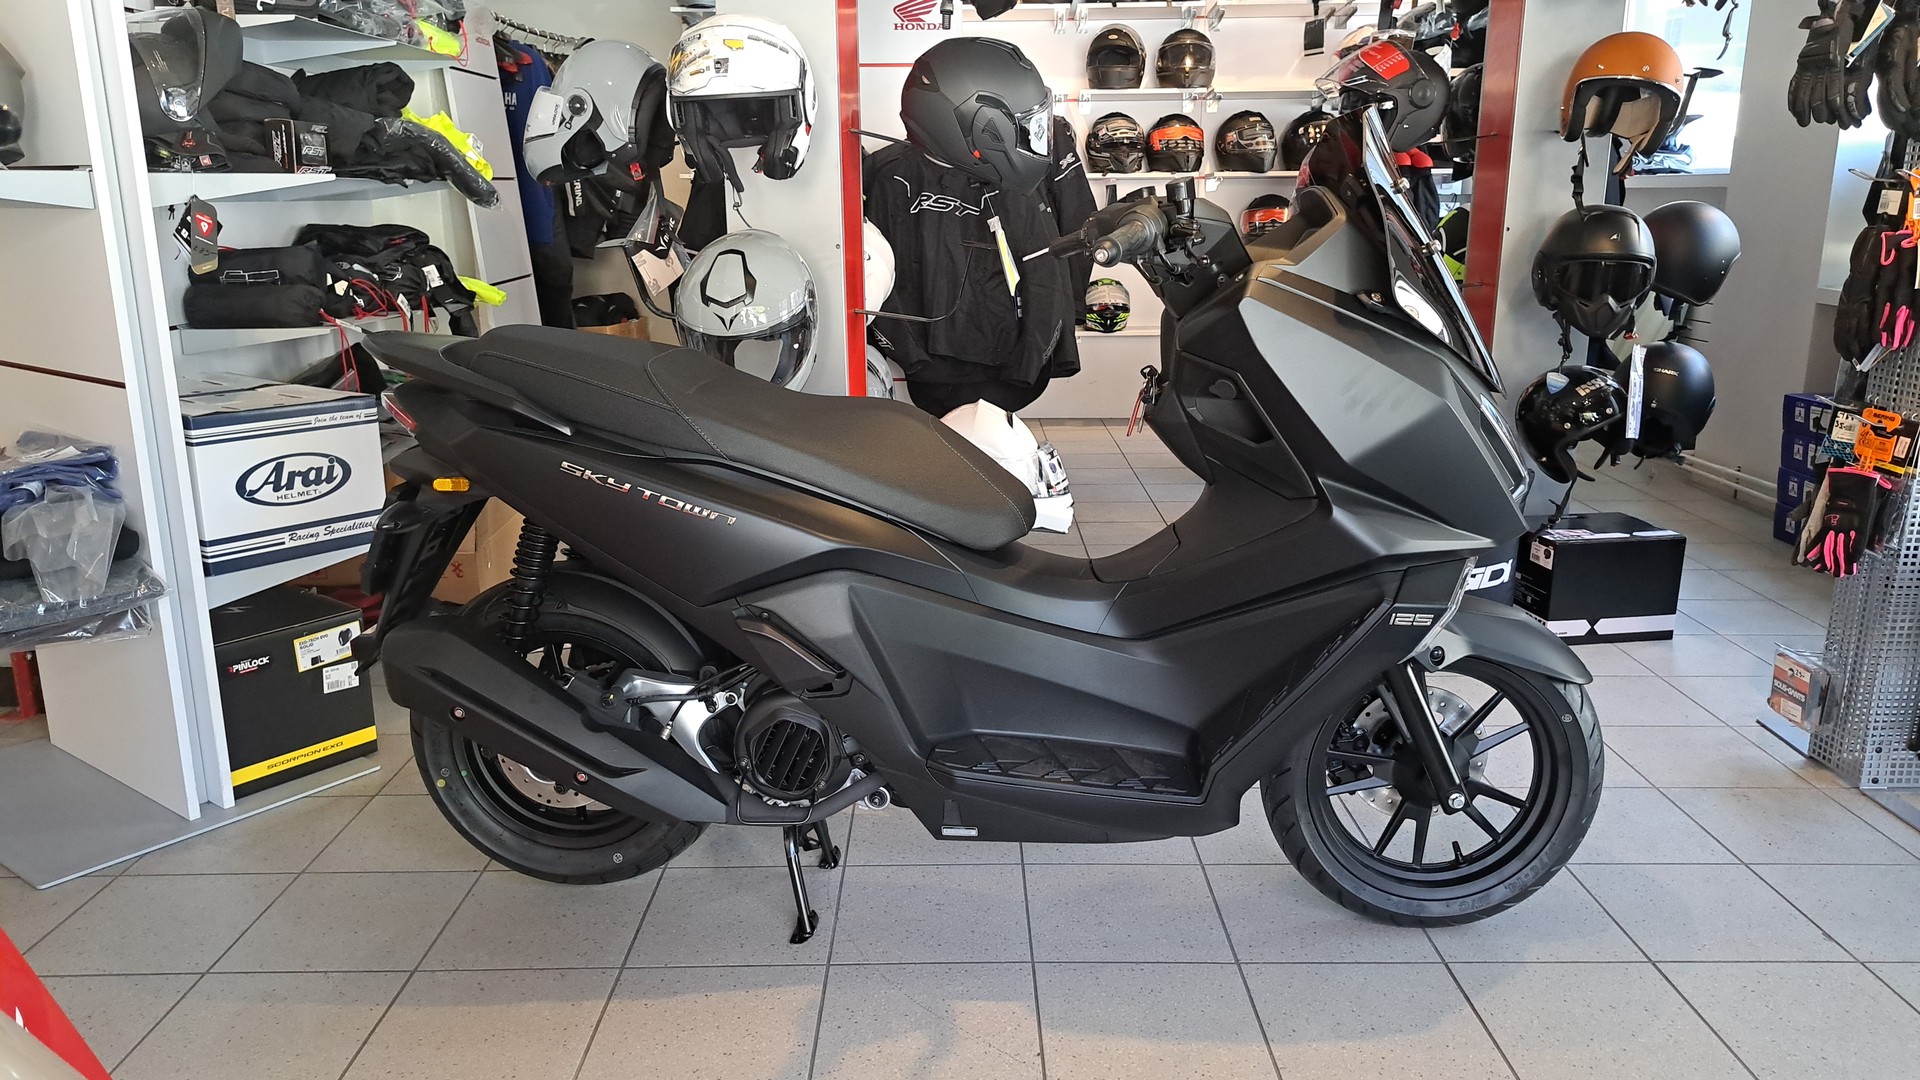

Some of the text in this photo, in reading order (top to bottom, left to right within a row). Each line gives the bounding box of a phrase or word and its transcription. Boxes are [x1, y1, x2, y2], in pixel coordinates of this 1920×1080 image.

[301, 145, 325, 157] RST
[910, 192, 981, 218] RST
[328, 414, 338, 422] the
[355, 412, 363, 420] of
[245, 456, 340, 498] Arai
[559, 460, 632, 493] SKY
[276, 488, 320, 502] HELMET
[288, 520, 373, 543] Racing Specialities
[1389, 612, 1435, 626] 125
[232, 655, 271, 673] PINLOCK
[266, 740, 344, 771] SCORPION EXO
